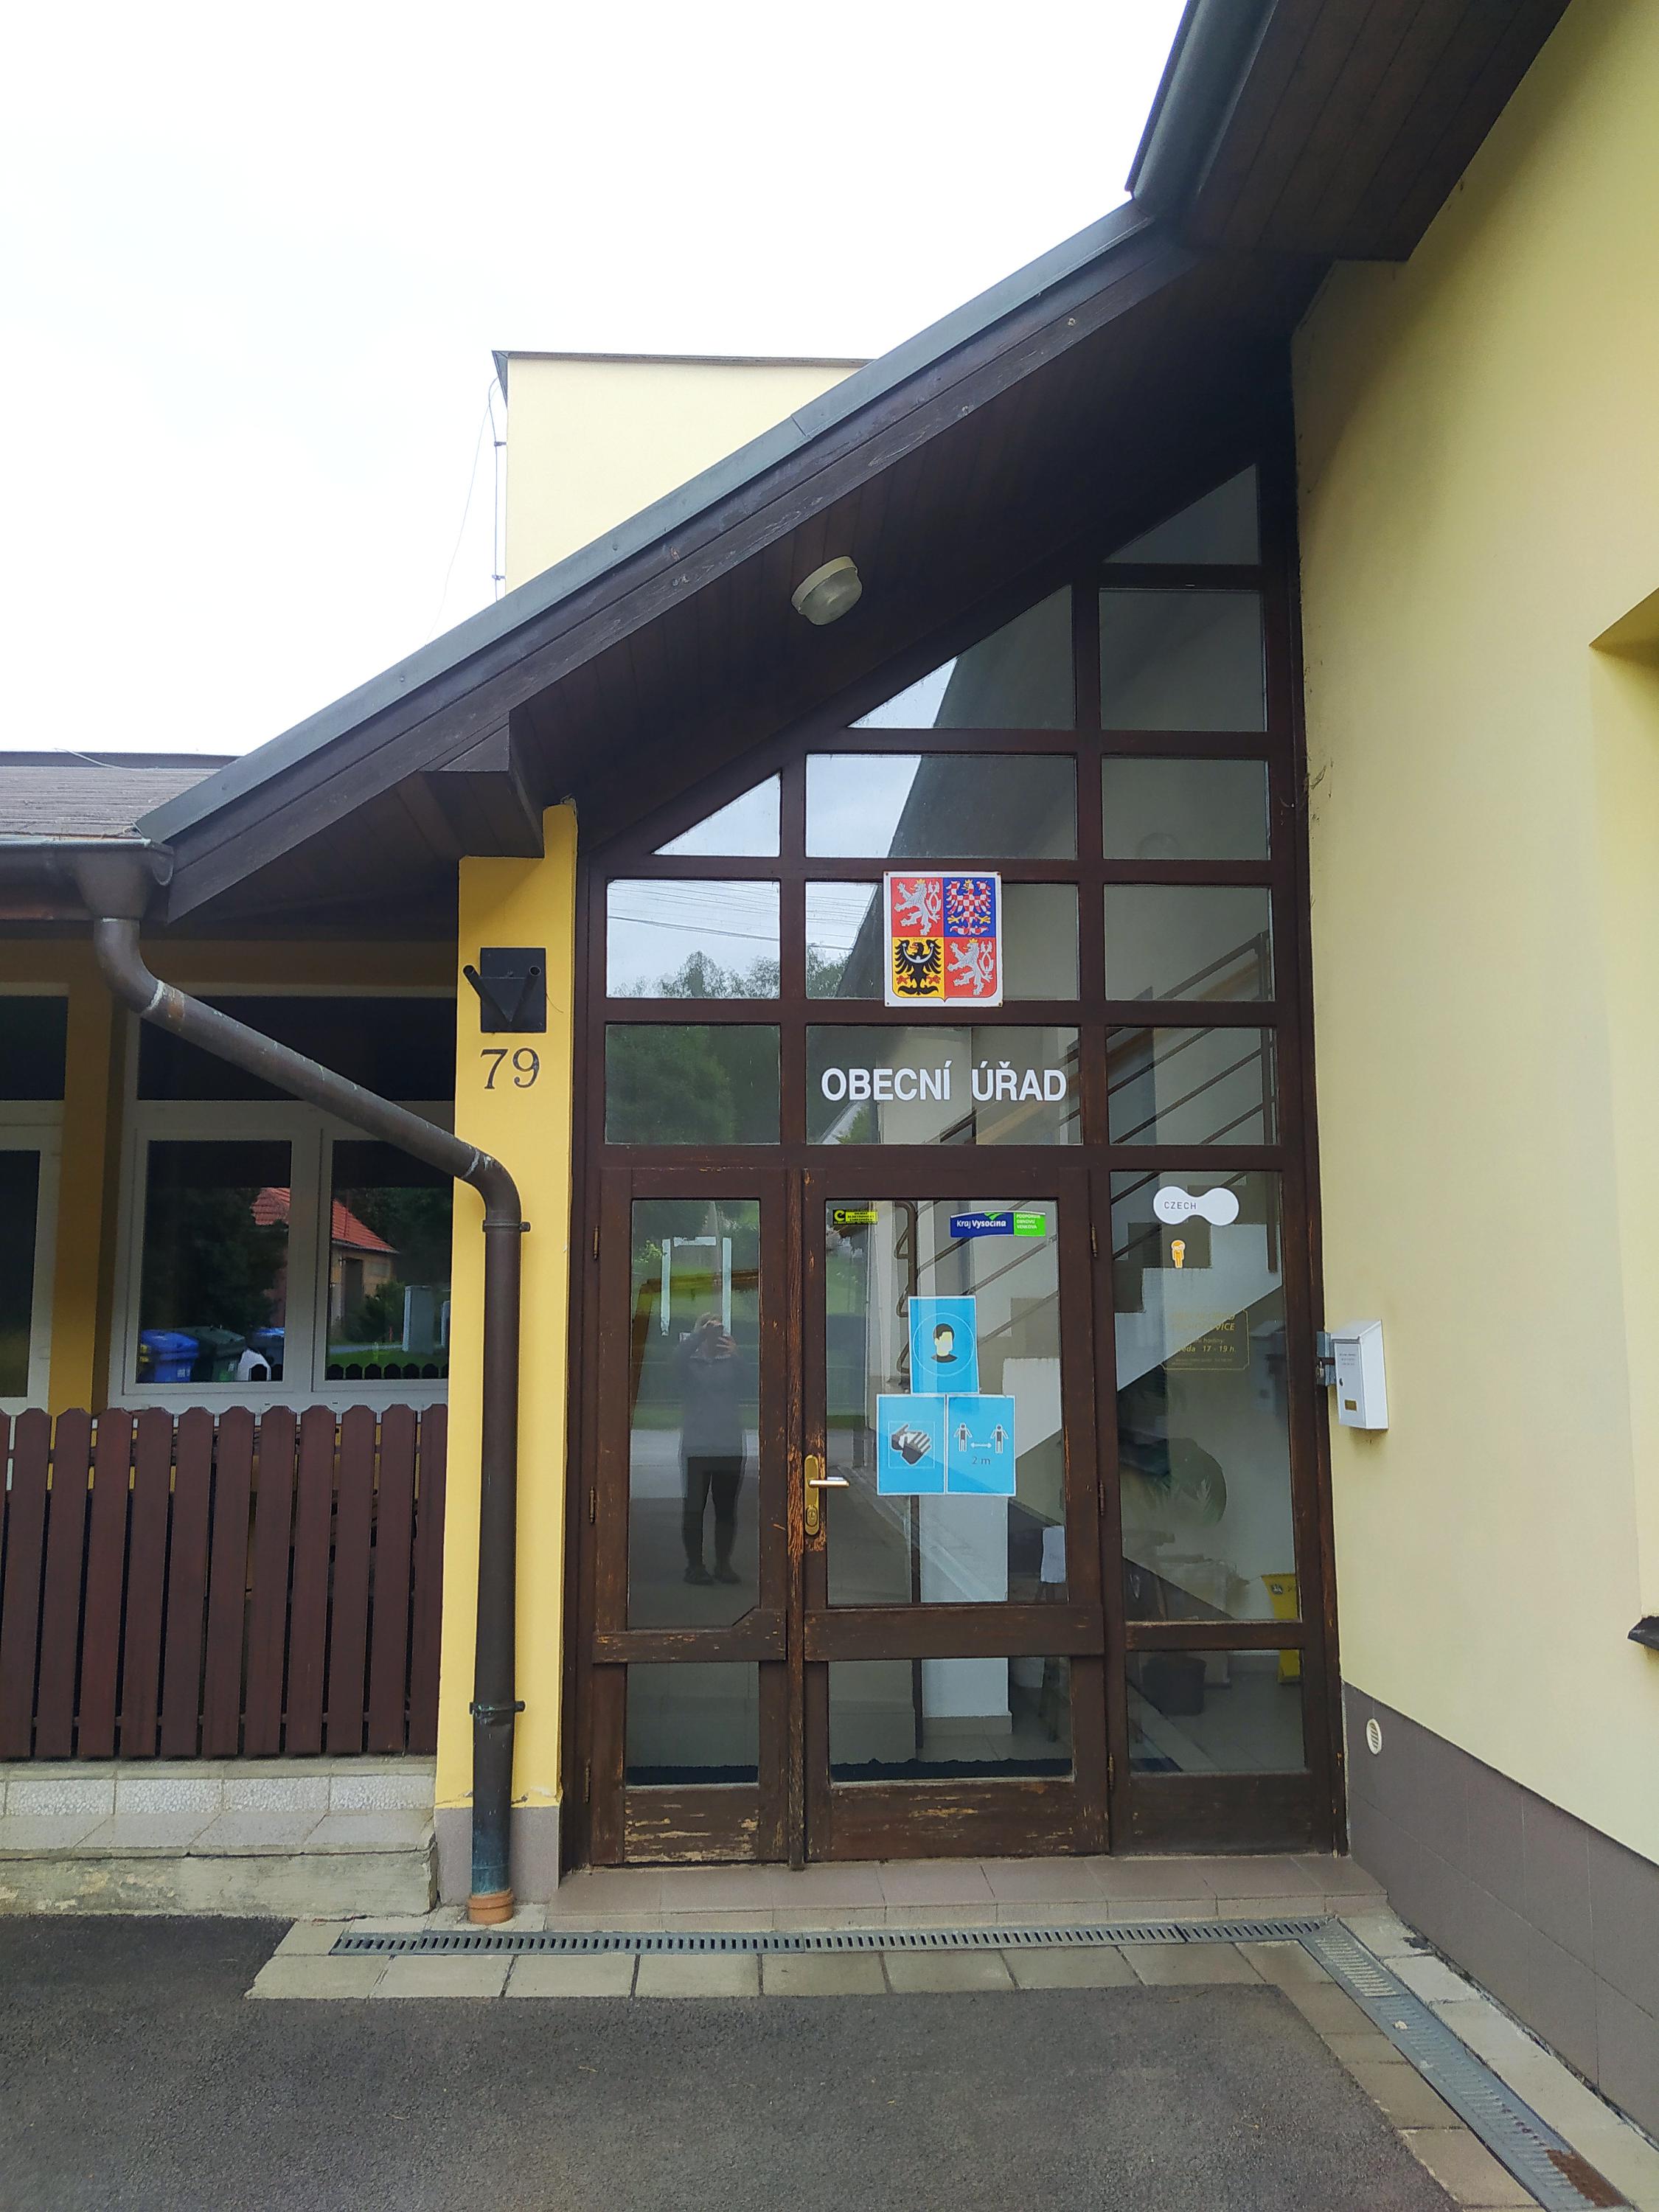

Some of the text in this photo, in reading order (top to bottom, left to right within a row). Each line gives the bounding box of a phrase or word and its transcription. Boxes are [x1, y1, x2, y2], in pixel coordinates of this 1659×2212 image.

[480, 1047, 540, 1090] 79
[821, 1060, 1067, 1102] OBECNÍ ÚŘAD
[1164, 1201, 1197, 1210] CZECH
[956, 1220, 971, 1229] Kraj
[972, 1456, 978, 1464] 2
